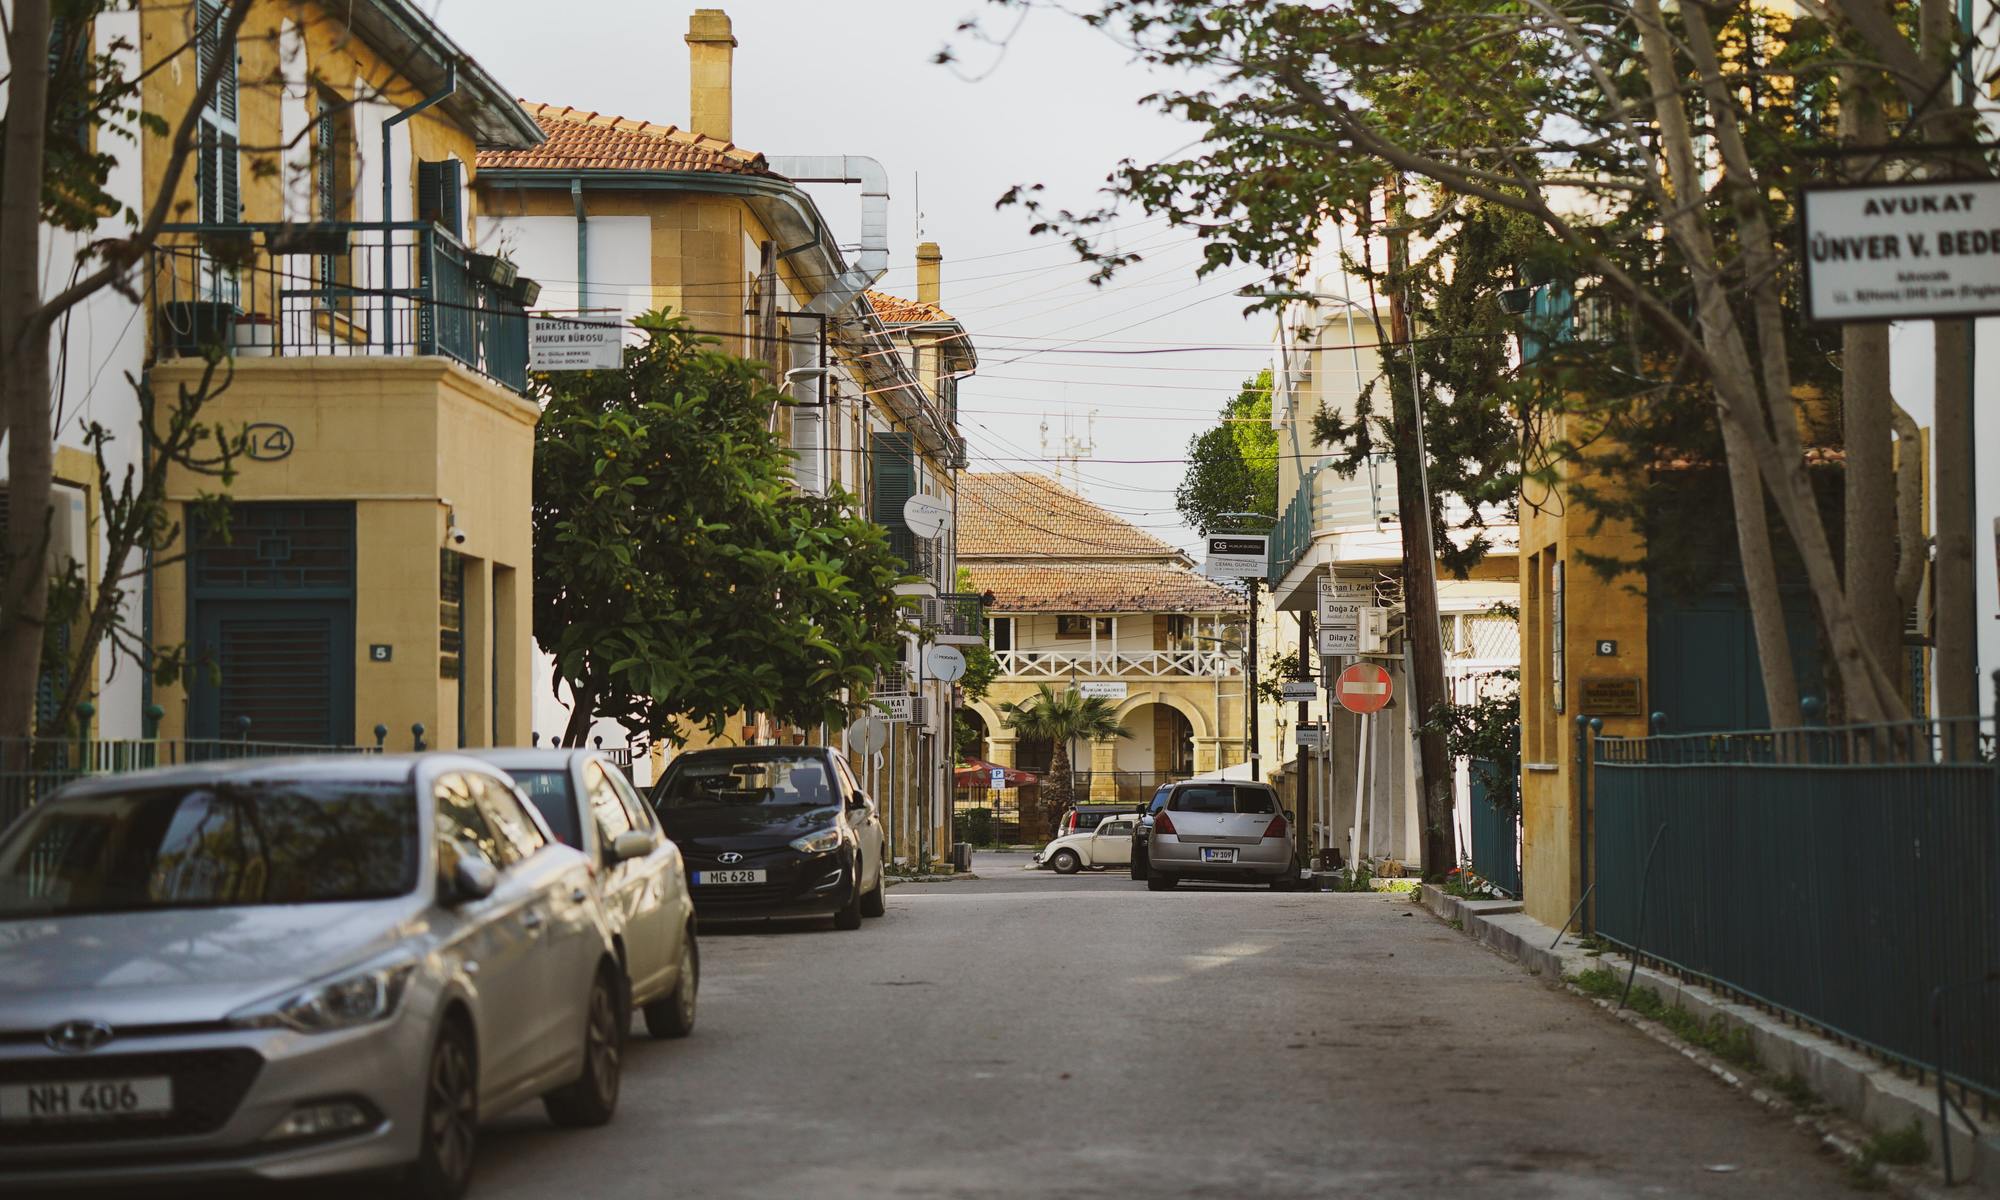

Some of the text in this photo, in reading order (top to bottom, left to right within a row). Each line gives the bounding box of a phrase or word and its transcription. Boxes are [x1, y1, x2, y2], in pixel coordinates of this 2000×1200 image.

[1864, 193, 1974, 217] AVUKAT
[1812, 230, 1899, 263] ÜNVER
[1908, 233, 1931, 258] V.
[535, 322, 571, 331] BERKSEL
[573, 322, 580, 330] &
[535, 333, 604, 343] HUKUK BÜROSU
[1329, 634, 1348, 642] Dilay
[375, 647, 386, 659] 5
[1600, 642, 1612, 654] 6
[710, 871, 755, 883] MG 628
[28, 1083, 138, 1113] NH 406
